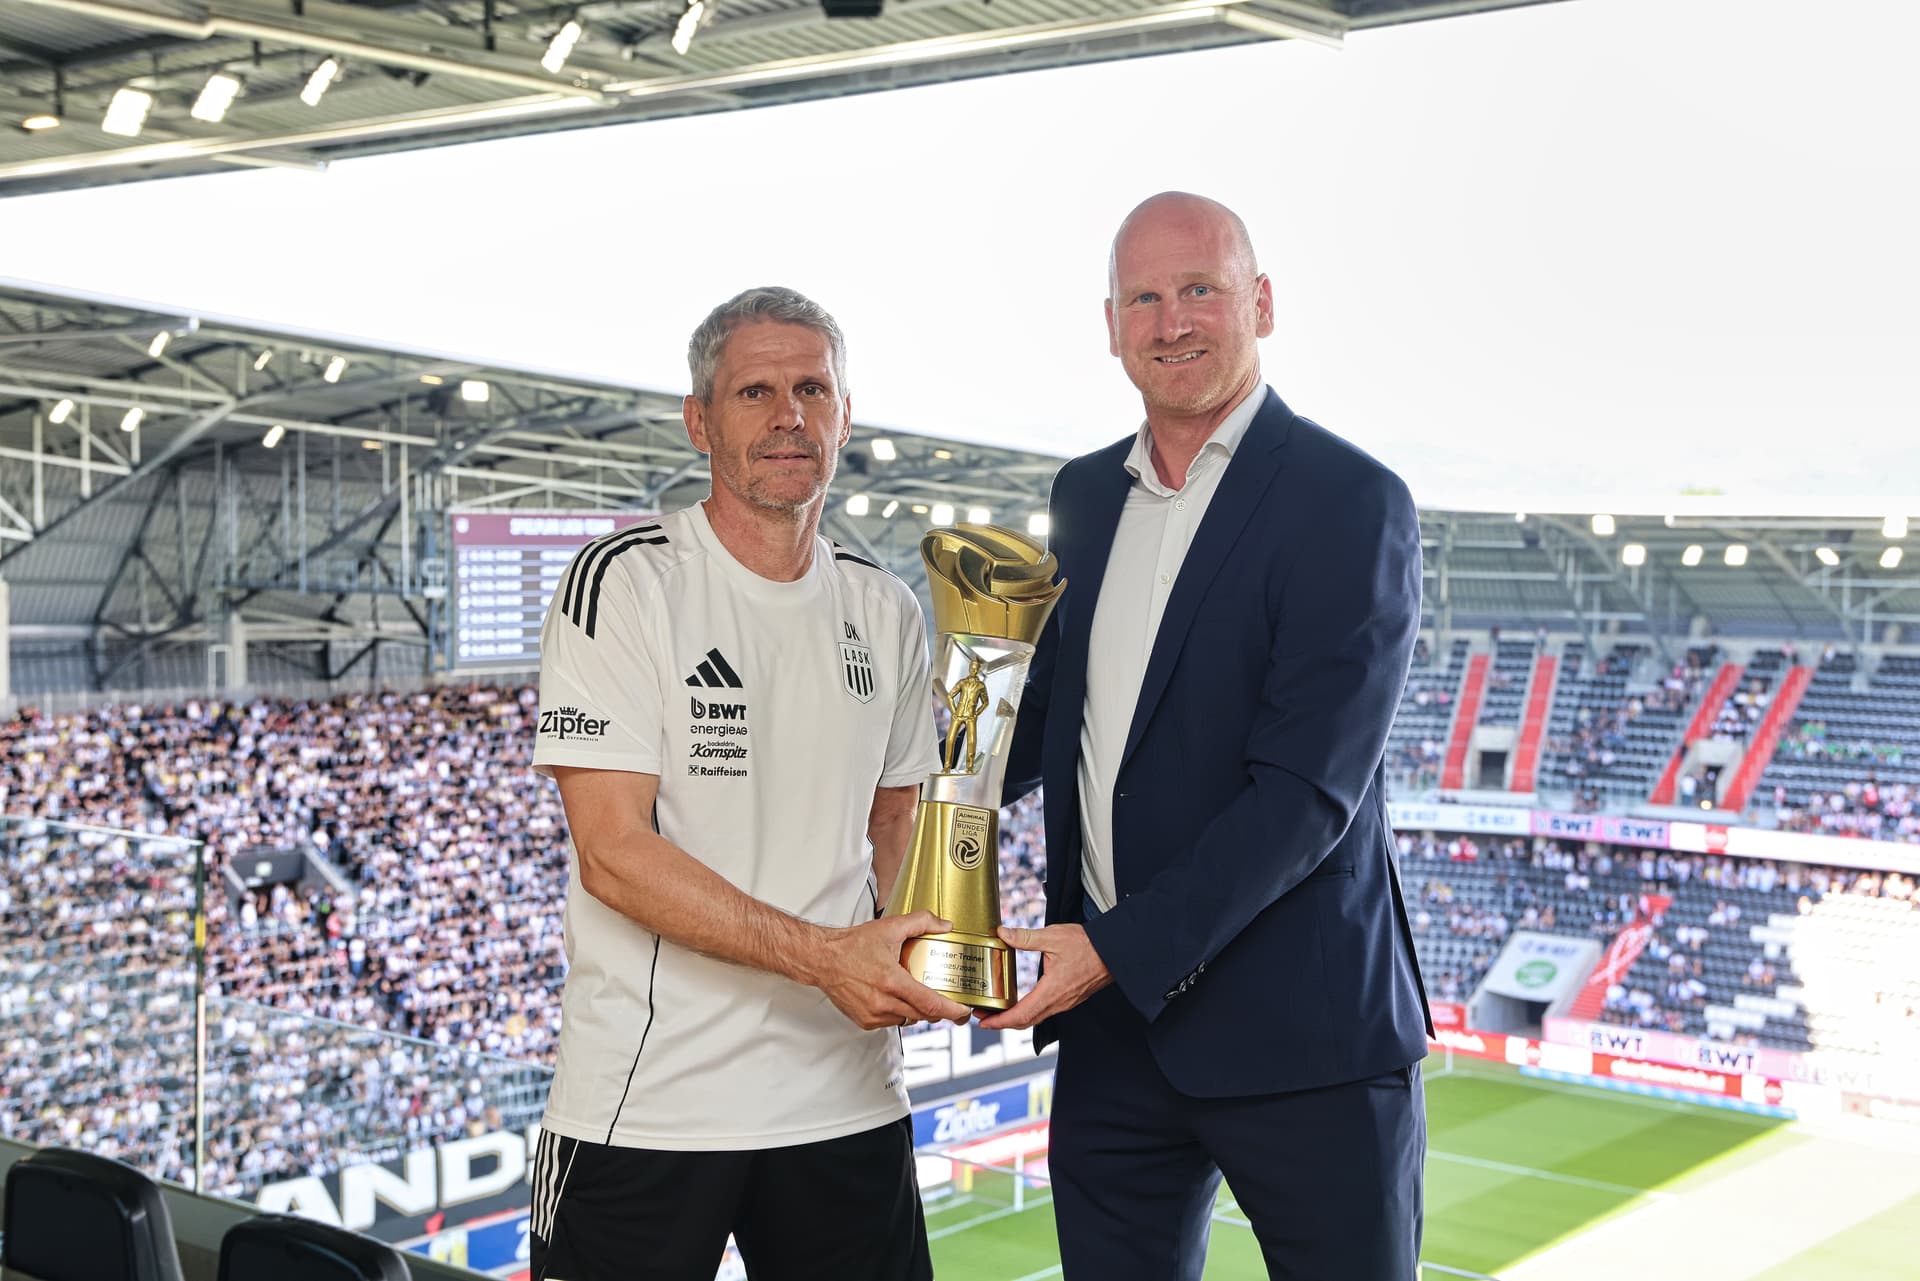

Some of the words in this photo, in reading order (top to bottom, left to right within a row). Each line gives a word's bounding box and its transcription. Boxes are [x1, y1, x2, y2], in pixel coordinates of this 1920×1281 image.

[844, 621, 860, 641] DK
[844, 648, 870, 664] LASK
[708, 703, 747, 720] BWT
[540, 710, 611, 739] Zipfer
[690, 743, 748, 761] Kornspitz
[700, 766, 748, 777] Raiffeisen
[956, 822, 985, 832] BUNDES
[962, 829, 978, 838] LIGA
[930, 949, 958, 959] Bter
[959, 952, 985, 963] Trainer
[939, 963, 977, 973] 025/2026
